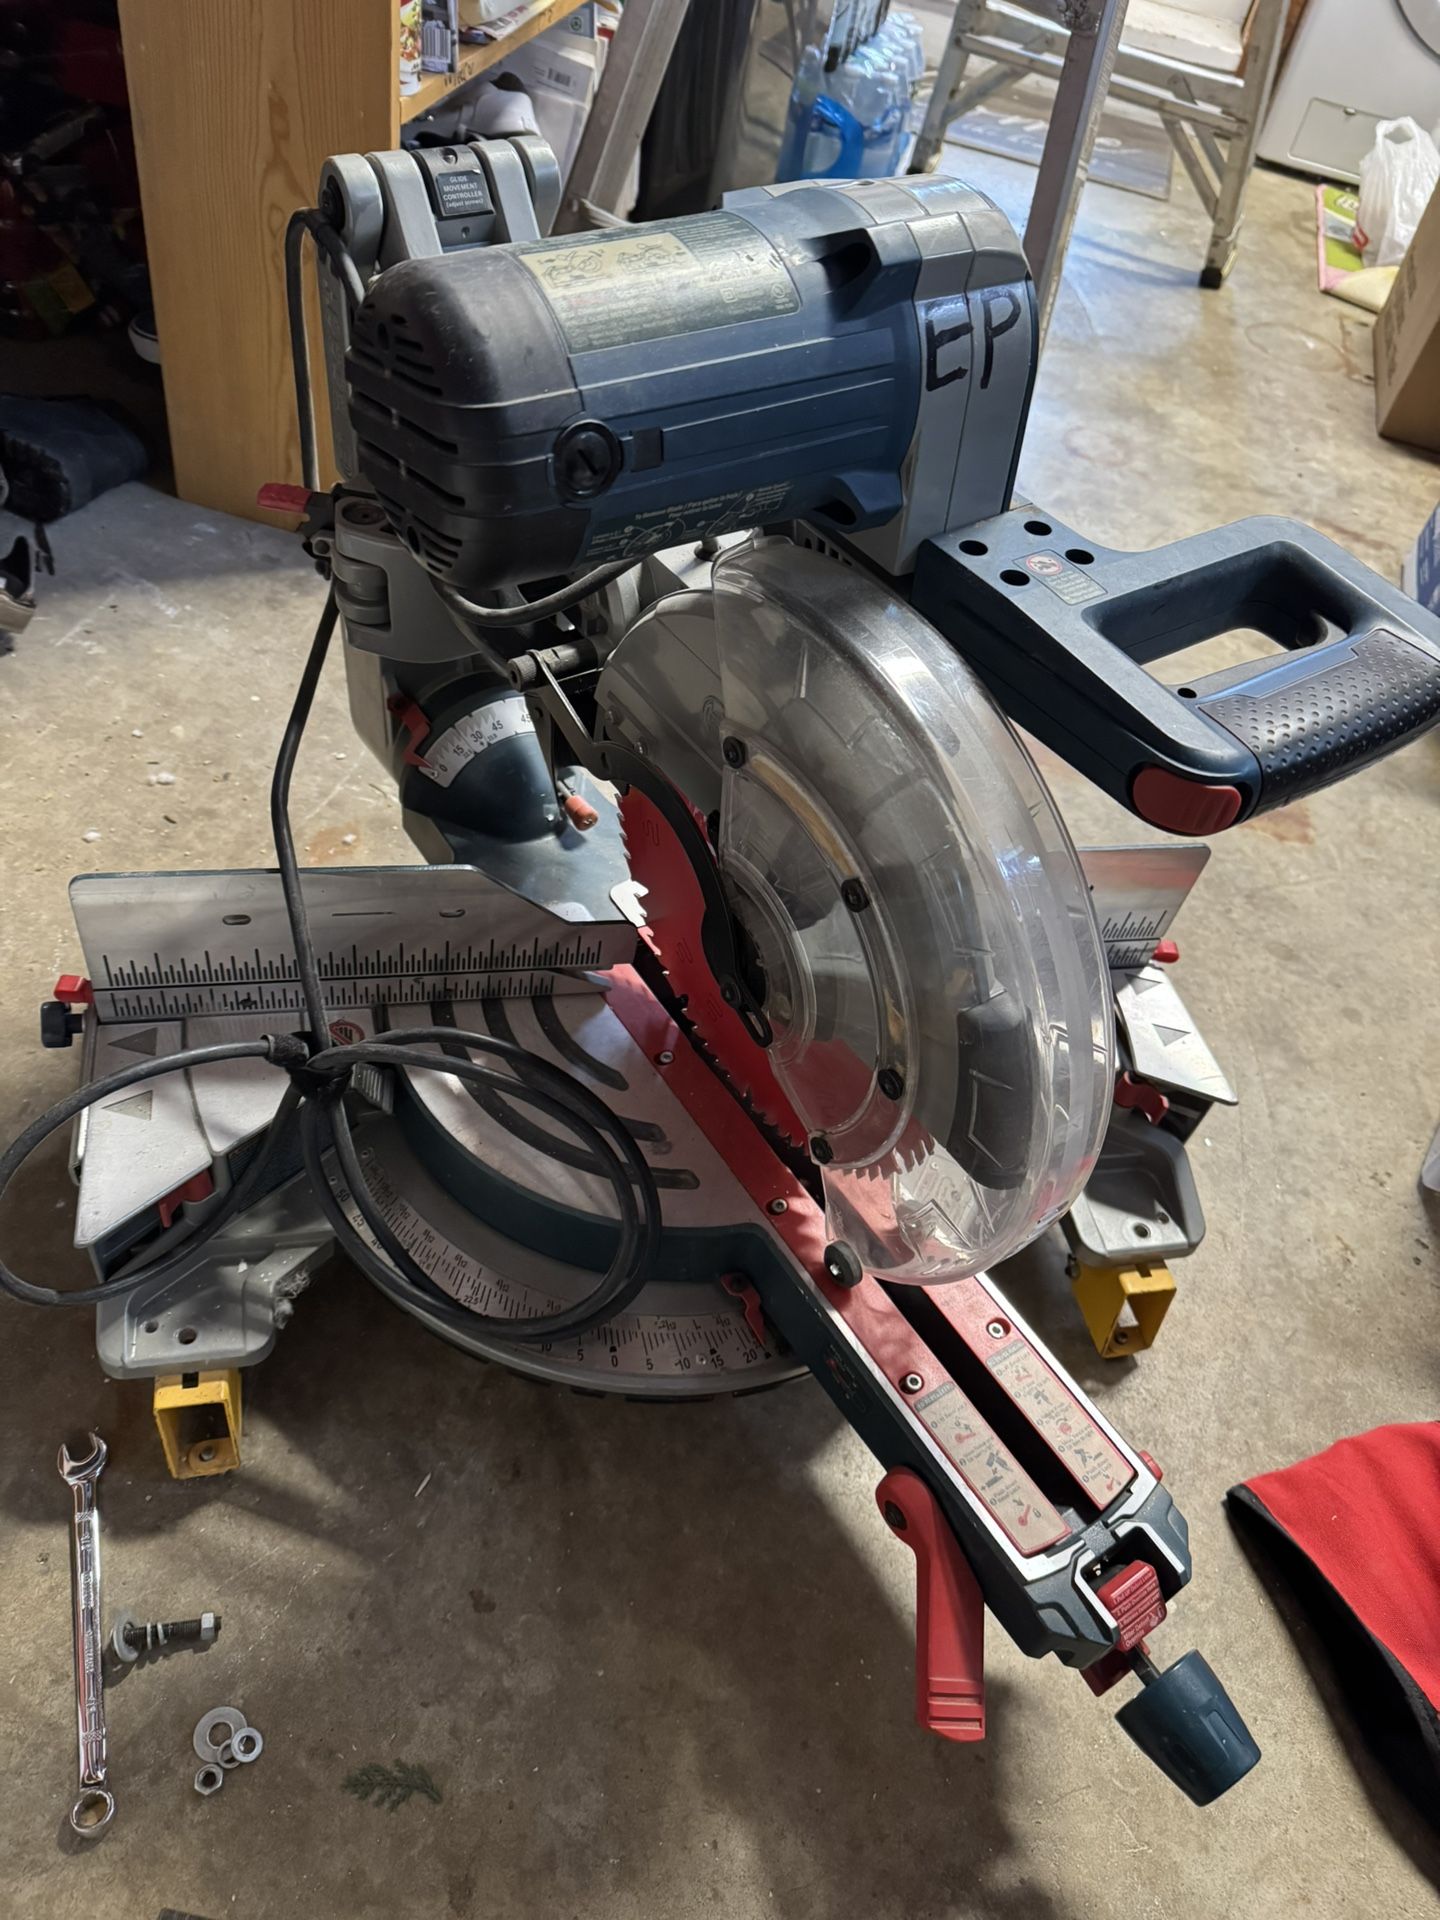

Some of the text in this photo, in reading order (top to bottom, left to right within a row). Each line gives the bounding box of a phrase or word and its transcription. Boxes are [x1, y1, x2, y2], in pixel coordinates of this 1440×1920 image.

[449, 175, 468, 183] GLIDE
[443, 182, 478, 192] MOVEMENT
[442, 190, 483, 201] CONTROLLER
[491, 720, 504, 732] 45
[470, 730, 483, 743] 30
[453, 745, 465, 757] 15
[439, 764, 448, 773] 0
[336, 1189, 351, 1203] 50
[463, 1294, 480, 1305] 22.5
[576, 1349, 585, 1362] 5
[610, 1355, 619, 1368] 0
[709, 1354, 725, 1369] 15
[742, 1348, 758, 1364] 20
[645, 1358, 654, 1371] 5
[676, 1357, 692, 1371] 10
